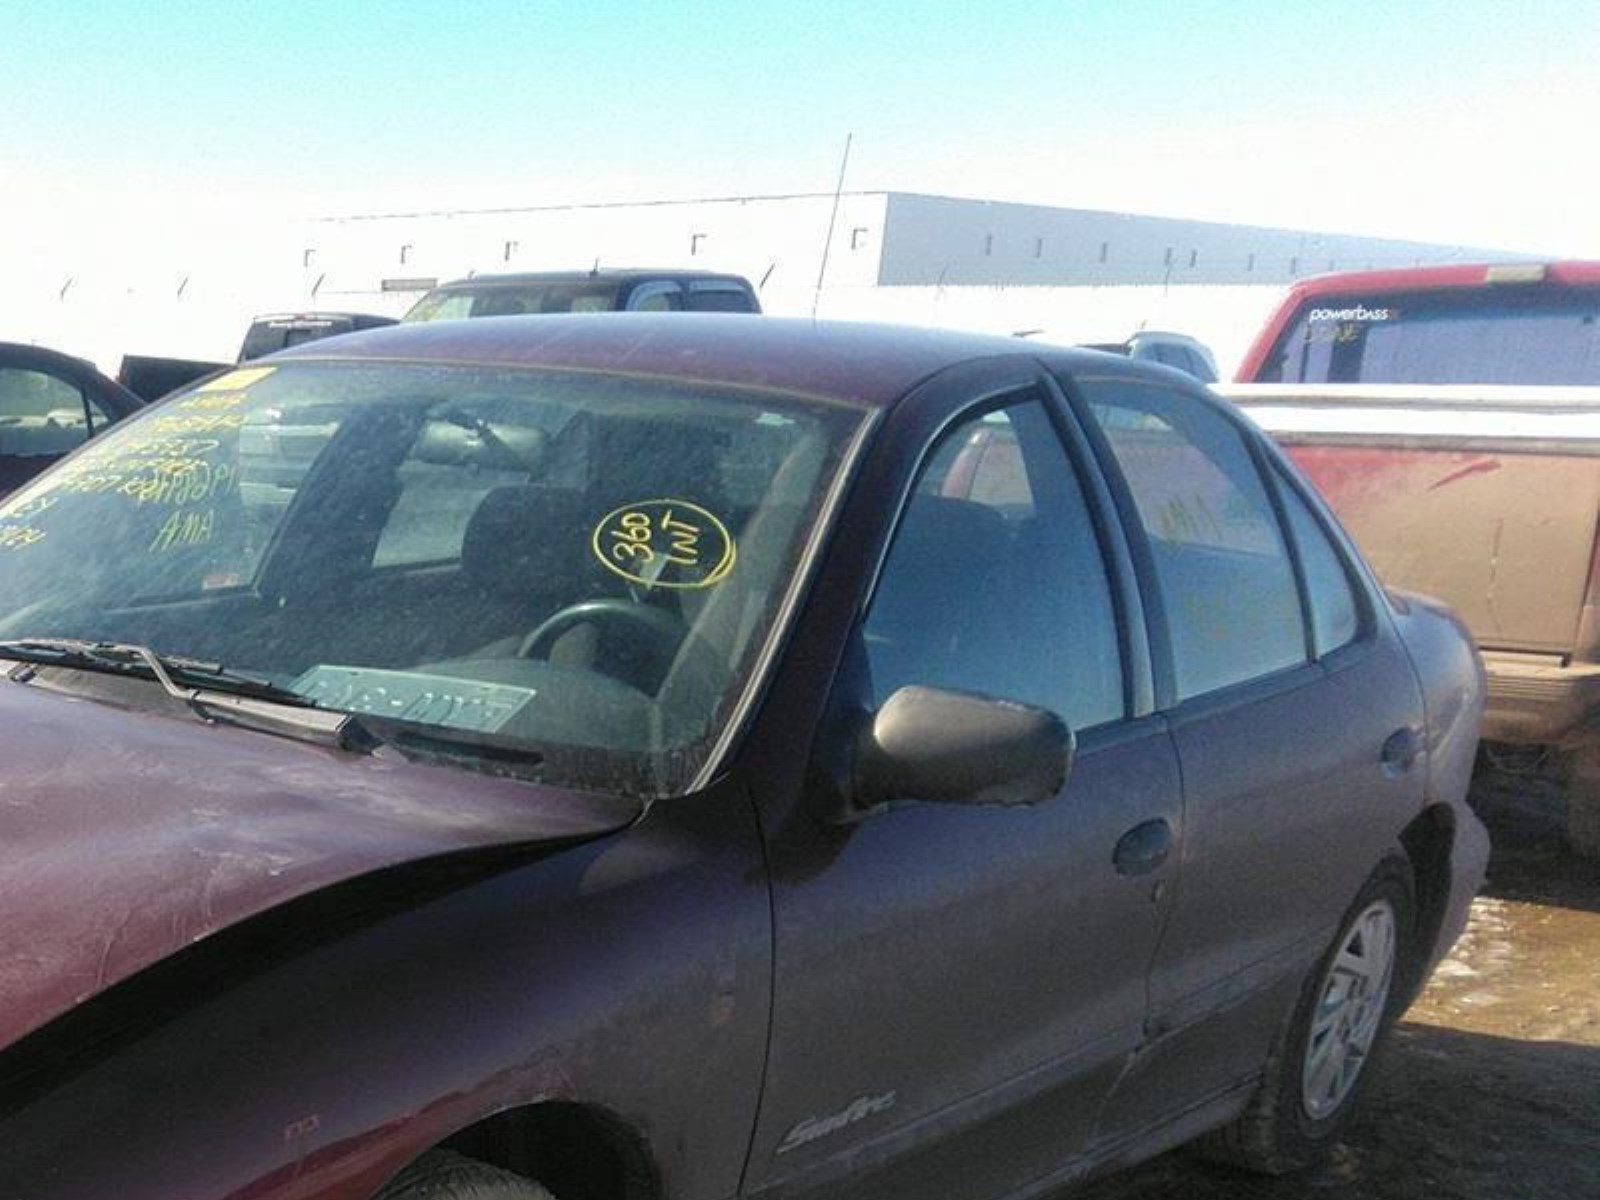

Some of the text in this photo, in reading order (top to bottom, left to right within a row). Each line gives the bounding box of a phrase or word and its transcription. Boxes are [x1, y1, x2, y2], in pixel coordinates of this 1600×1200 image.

[1309, 304, 1389, 324] powerbass
[611, 511, 654, 563] 360
[660, 508, 702, 566] INT
